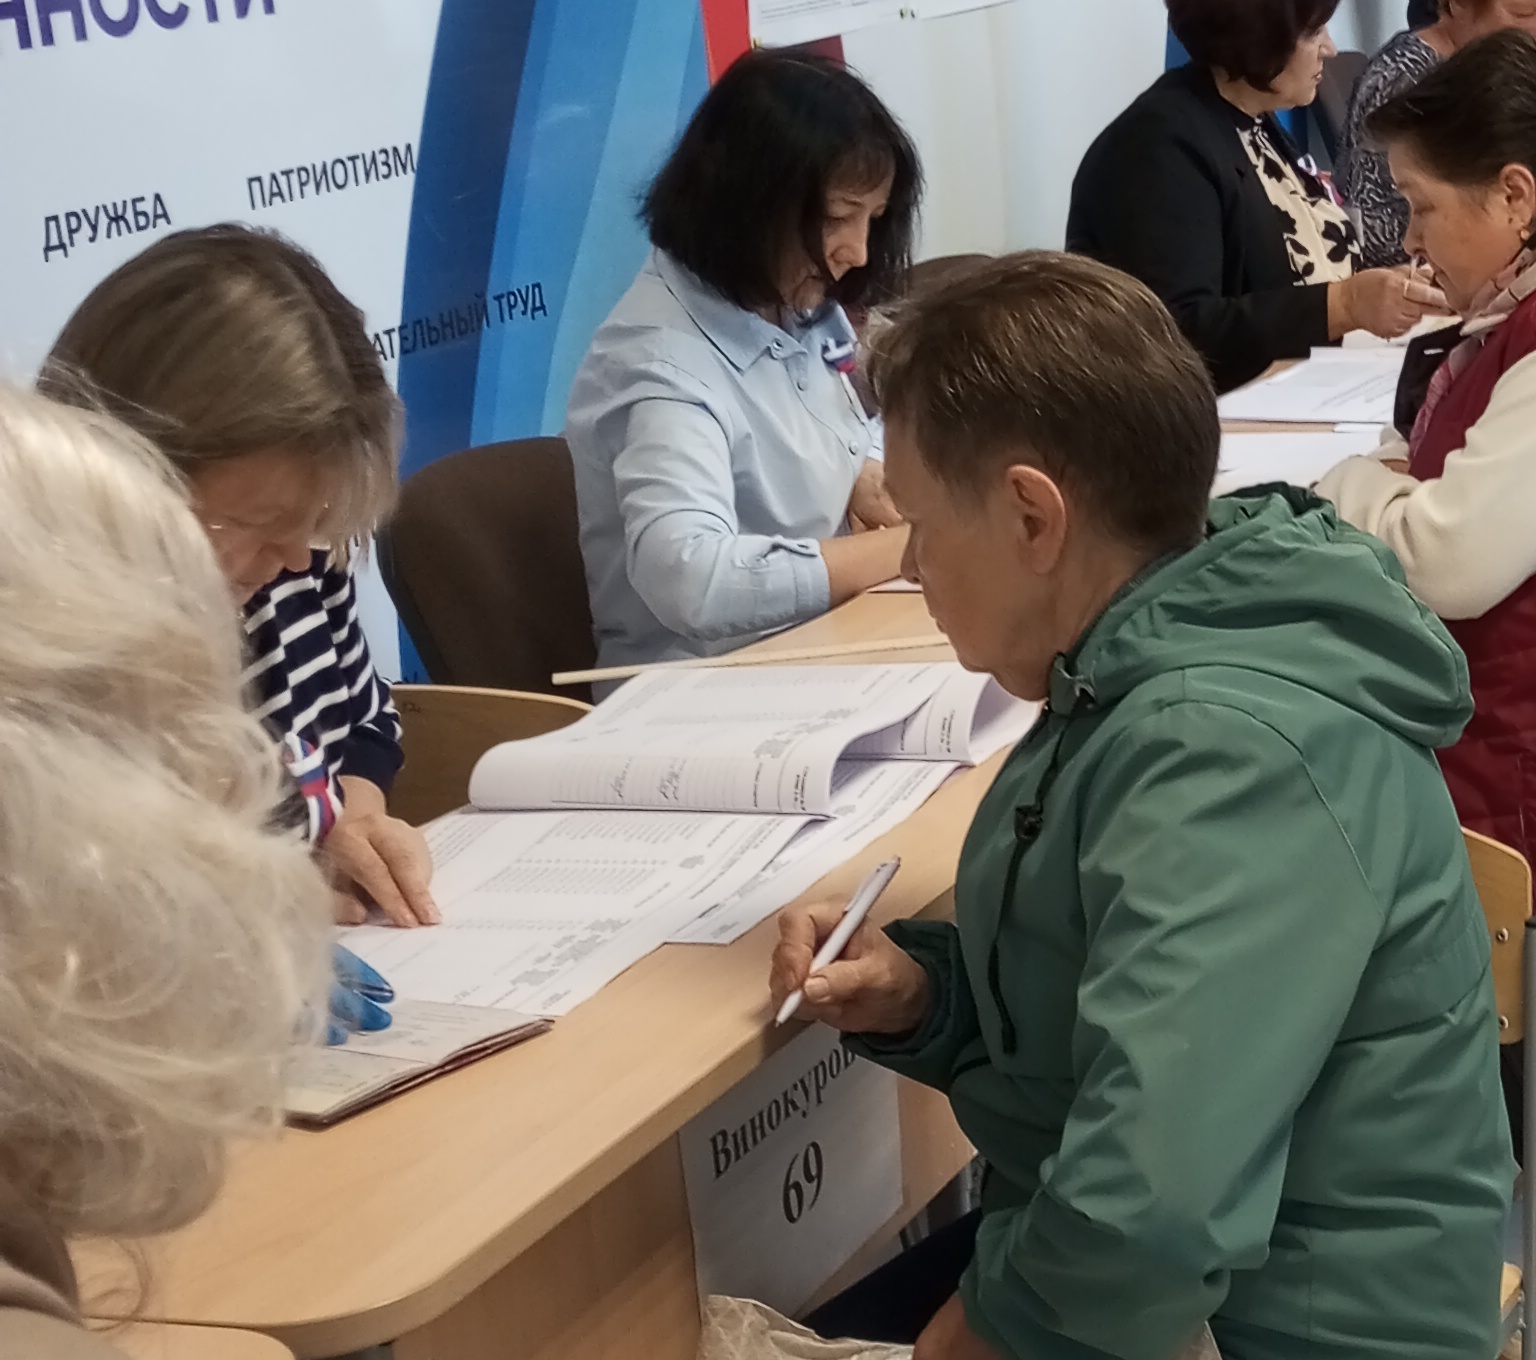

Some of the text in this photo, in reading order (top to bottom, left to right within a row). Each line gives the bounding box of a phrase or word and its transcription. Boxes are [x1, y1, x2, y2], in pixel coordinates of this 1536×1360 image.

[247, 142, 416, 211] ПАТРИОТИЗМ
[43, 192, 172, 263] ДРУЖБА
[493, 282, 547, 323] ТРУД
[783, 1140, 823, 1225] 69
